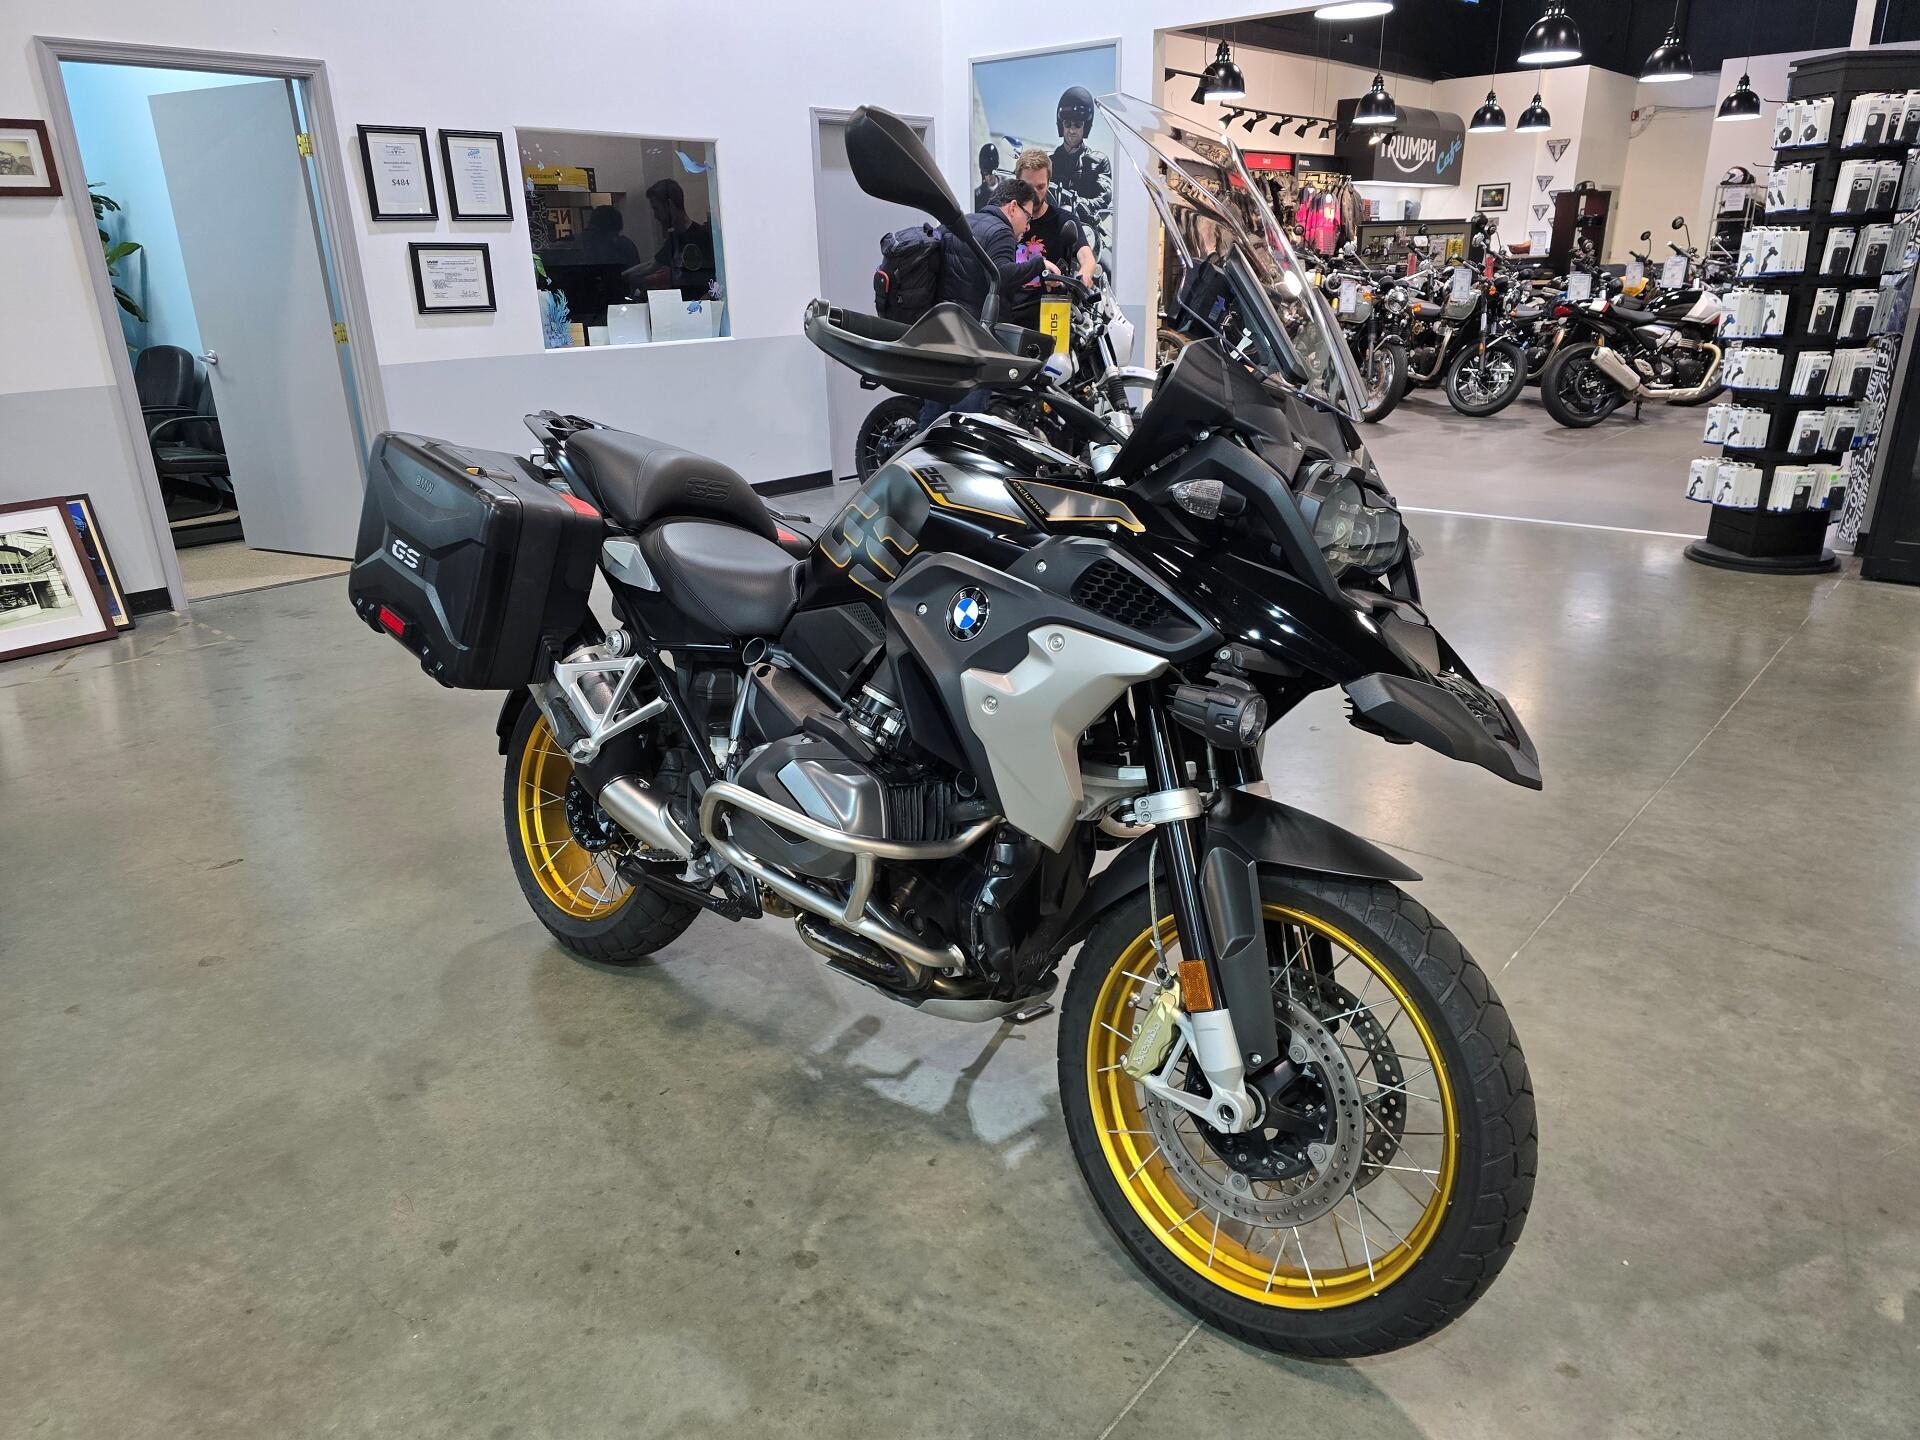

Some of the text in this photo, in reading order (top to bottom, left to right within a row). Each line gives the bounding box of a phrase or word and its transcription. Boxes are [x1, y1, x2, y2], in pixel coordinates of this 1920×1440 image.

[1436, 134, 1463, 175] Café
[1050, 312, 1058, 341] SOL
[415, 473, 436, 495] BMW
[1012, 480, 1046, 516] exclusive
[392, 538, 421, 569] GS
